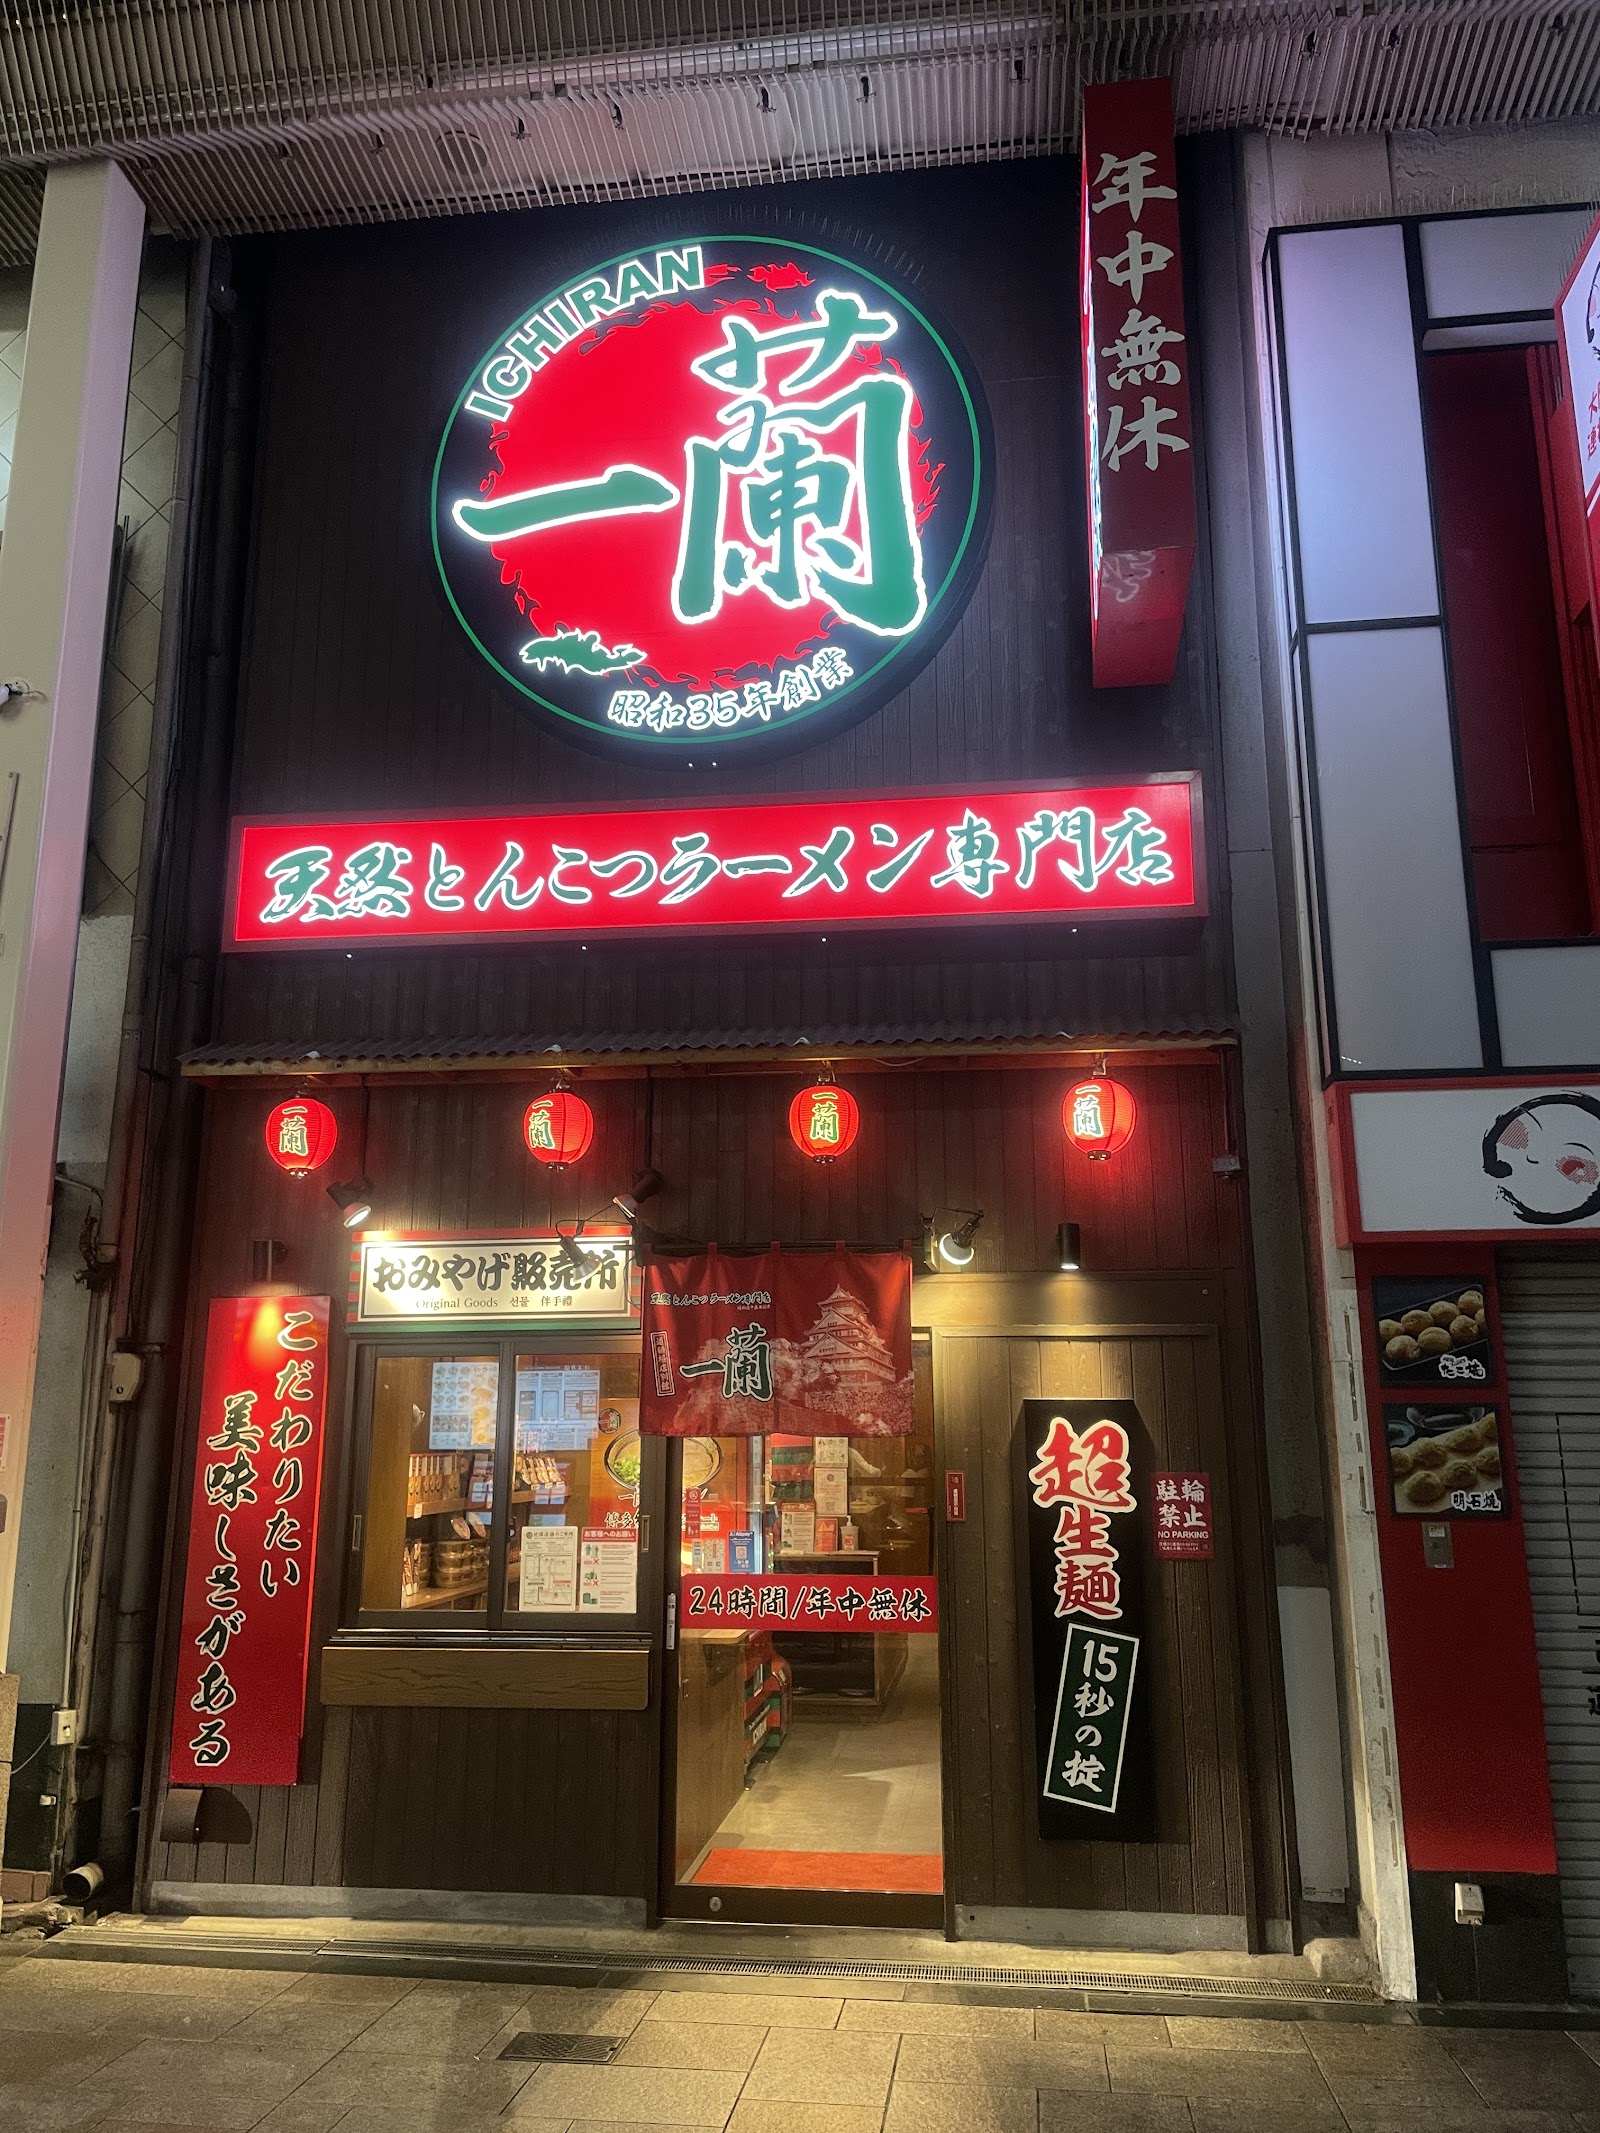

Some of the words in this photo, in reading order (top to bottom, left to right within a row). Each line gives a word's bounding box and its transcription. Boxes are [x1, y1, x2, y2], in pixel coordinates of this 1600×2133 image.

[464, 246, 705, 422] ICHIRAN
[1092, 151, 1190, 472] 年中無休
[452, 289, 927, 636] 一蘭
[607, 646, 855, 732] 昭和35年創業
[260, 805, 1174, 924] 天然とんこつラーメン専門店
[279, 1105, 308, 1156] 一蘭
[529, 1100, 555, 1150] 一蘭
[810, 1091, 839, 1143] 一蘭
[1072, 1085, 1104, 1137] 一蘭
[416, 1298, 460, 1310] Original
[464, 1297, 499, 1308] Goods
[680, 1322, 773, 1402] 一蘭
[260, 1311, 318, 1598] こだわりたい
[1029, 1417, 1137, 1620] 超生麺
[1156, 1479, 1206, 1503] 駐輪
[1159, 1504, 1207, 1529] 禁止
[1451, 1490, 1502, 1512] 明石焼
[1157, 1531, 1170, 1539] NO
[1172, 1531, 1209, 1539] PARKING
[189, 1390, 265, 1768] 美味しさがある
[689, 1585, 932, 1622] 24時間/年中無休
[1062, 1639, 1120, 1793] 15秒の掟
